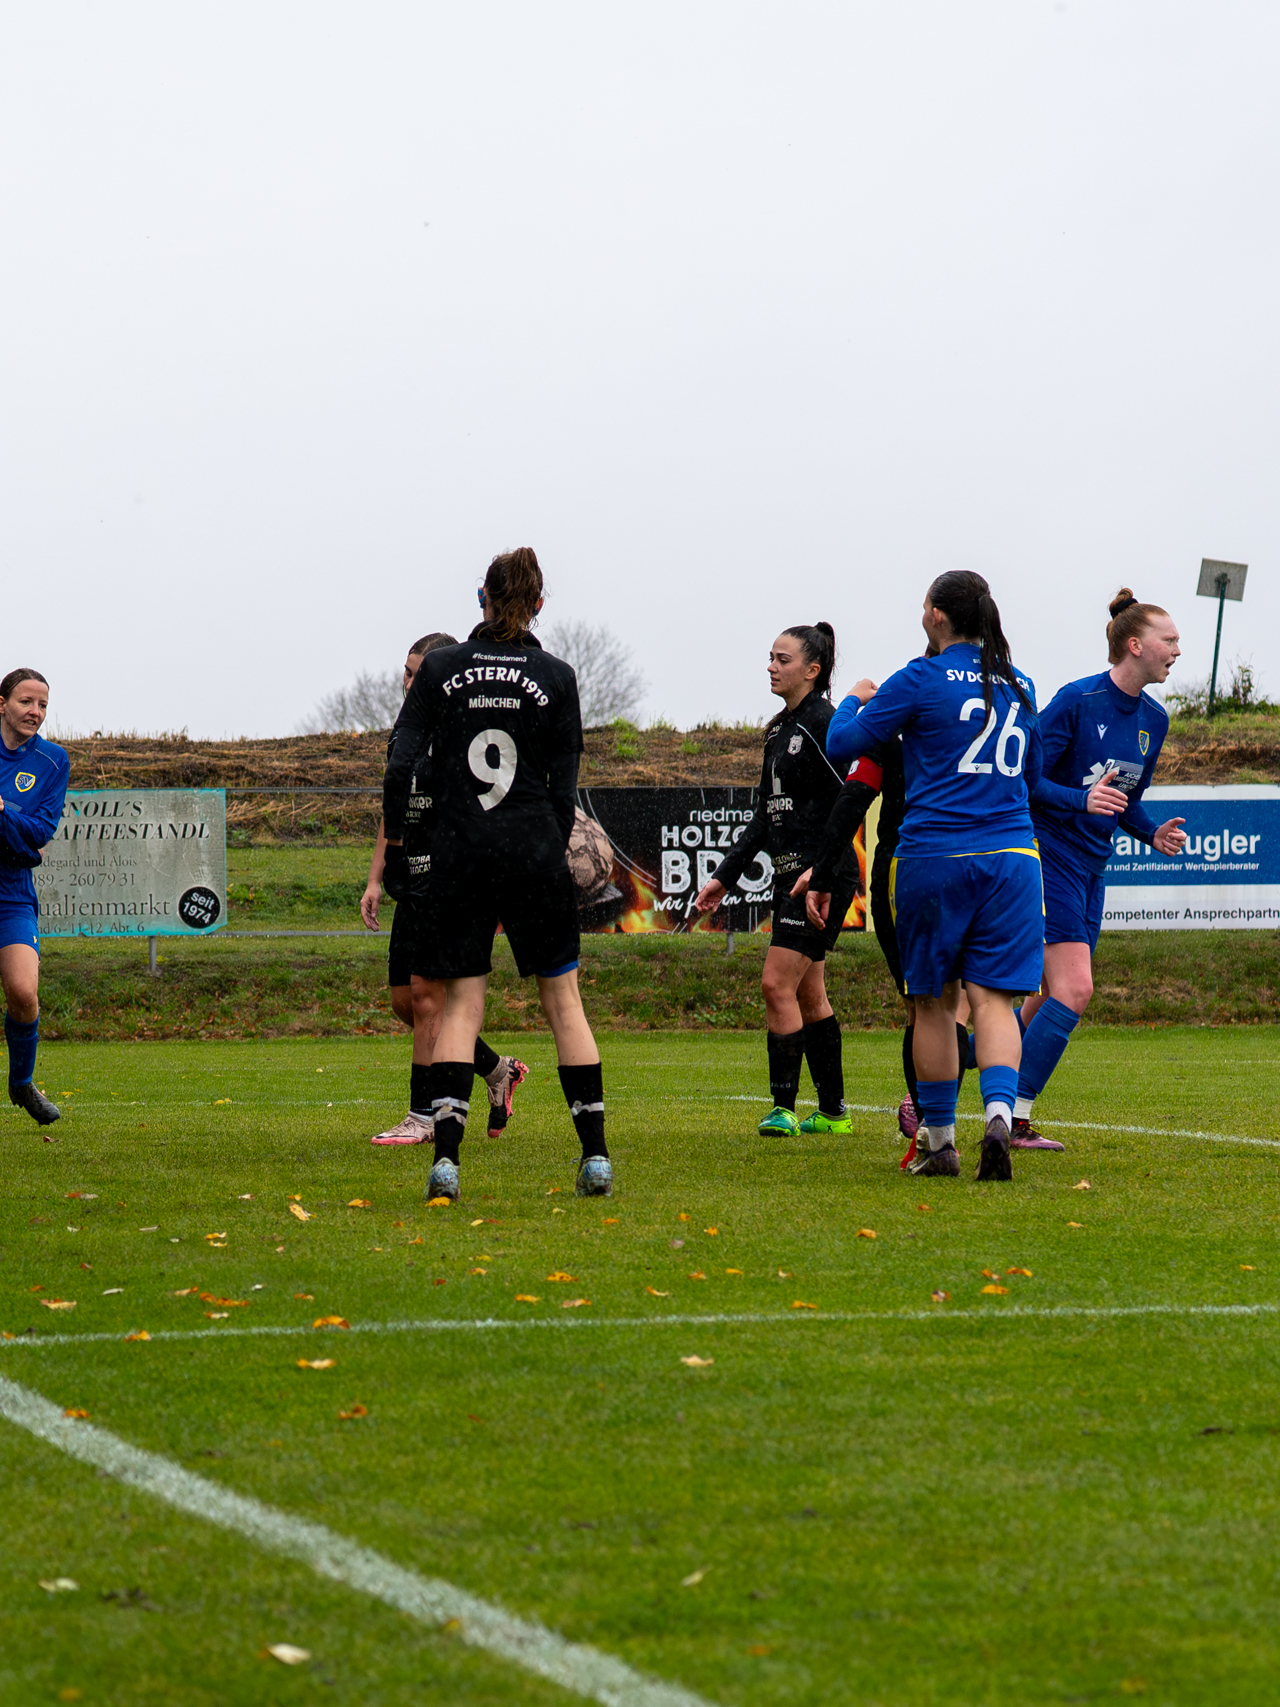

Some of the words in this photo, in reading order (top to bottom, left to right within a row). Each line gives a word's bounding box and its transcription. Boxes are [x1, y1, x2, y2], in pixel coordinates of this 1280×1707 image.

[946, 669, 964, 682] SV
[442, 674, 463, 697] FC
[464, 666, 521, 684] STERN
[521, 677, 549, 706] 1919
[468, 694, 521, 709] MÜNCHEN
[958, 697, 1026, 777] 26
[467, 728, 518, 811] 9
[51, 822, 211, 841] AFFEESTANDL
[84, 855, 106, 868] und
[109, 855, 138, 868] Alois
[1114, 862, 1131, 872] und
[1132, 861, 1183, 872] Zertifizierter
[1184, 861, 1261, 873] Wertpapierberater
[190, 890, 216, 911] seit
[182, 901, 212, 924] 1974
